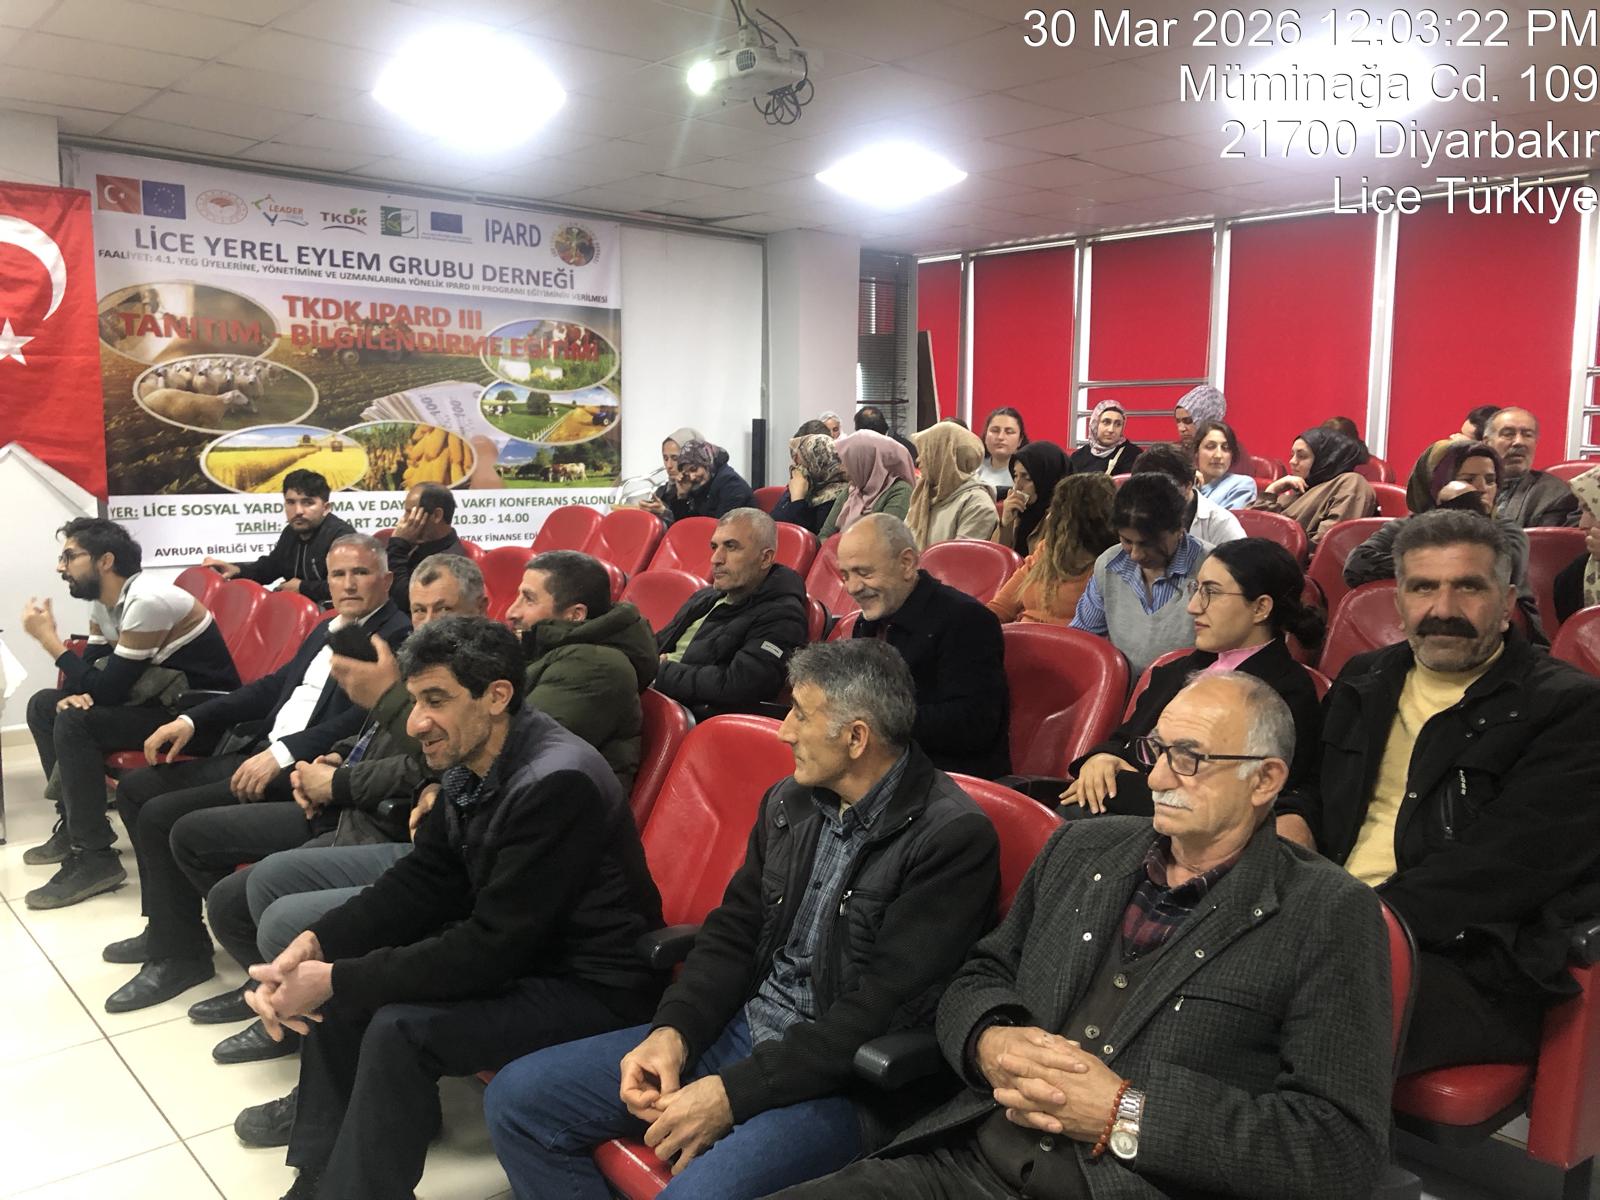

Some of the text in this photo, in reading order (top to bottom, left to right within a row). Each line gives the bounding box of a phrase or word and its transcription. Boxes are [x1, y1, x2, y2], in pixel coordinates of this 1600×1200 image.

[269, 204, 304, 215] LEADER
[320, 211, 367, 226] TKDK
[485, 218, 541, 247] IPARD
[135, 226, 575, 290] LİCE YEREL EYLEM GRUBU DERNEĞİ
[178, 257, 198, 267] YEG
[262, 264, 322, 278] YÖNETİMİNE
[325, 270, 337, 279] VE
[340, 271, 406, 285] UZMANLARINA
[409, 277, 444, 288] YÖNELİK
[446, 281, 471, 290] IPARD
[282, 294, 482, 330] TKDK IPARD III
[118, 312, 261, 344] TANITIM
[291, 320, 503, 356] BİLGİLENDİRME
[110, 507, 138, 518] YER:
[143, 503, 176, 516] LİCE
[181, 503, 240, 515] SOSYAL
[359, 501, 376, 511] VE
[462, 498, 495, 508] VAKFI
[500, 496, 568, 507] KONFERANS
[571, 495, 616, 505] SALONU
[236, 520, 281, 533] TARİH:
[345, 518, 371, 528] ART
[375, 517, 399, 528] 202
[454, 514, 486, 525] 10.30
[498, 513, 529, 523] 14.00
[155, 546, 203, 557] AVRUPA
[207, 543, 247, 554] BİRLİĞİ
[250, 544, 264, 553] VE
[459, 534, 483, 543] RTAK
[485, 532, 521, 543] FİNANSE
